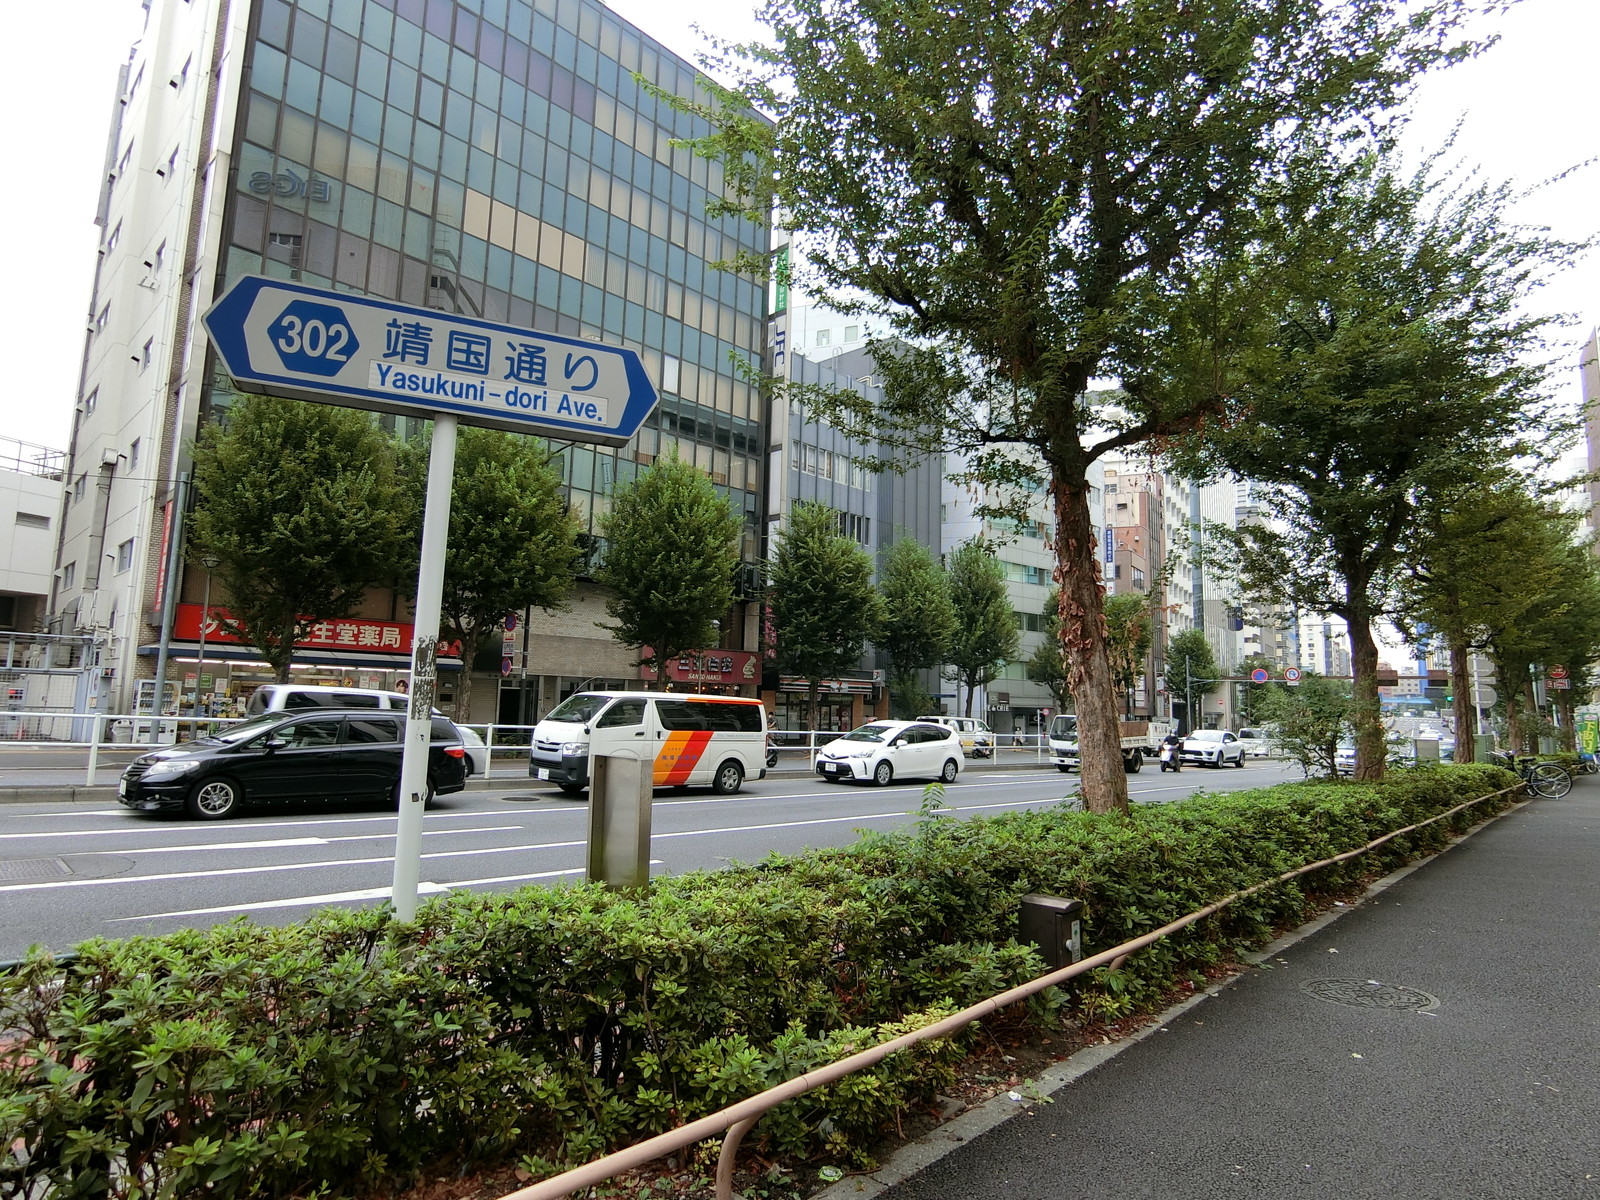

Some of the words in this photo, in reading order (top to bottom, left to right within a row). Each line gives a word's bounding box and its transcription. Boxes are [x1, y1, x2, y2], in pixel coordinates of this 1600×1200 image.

[277, 314, 350, 363] 302
[382, 317, 600, 392] 靖国通り
[375, 362, 549, 413] Yasukuni-dori
[557, 394, 604, 422] Ave.
